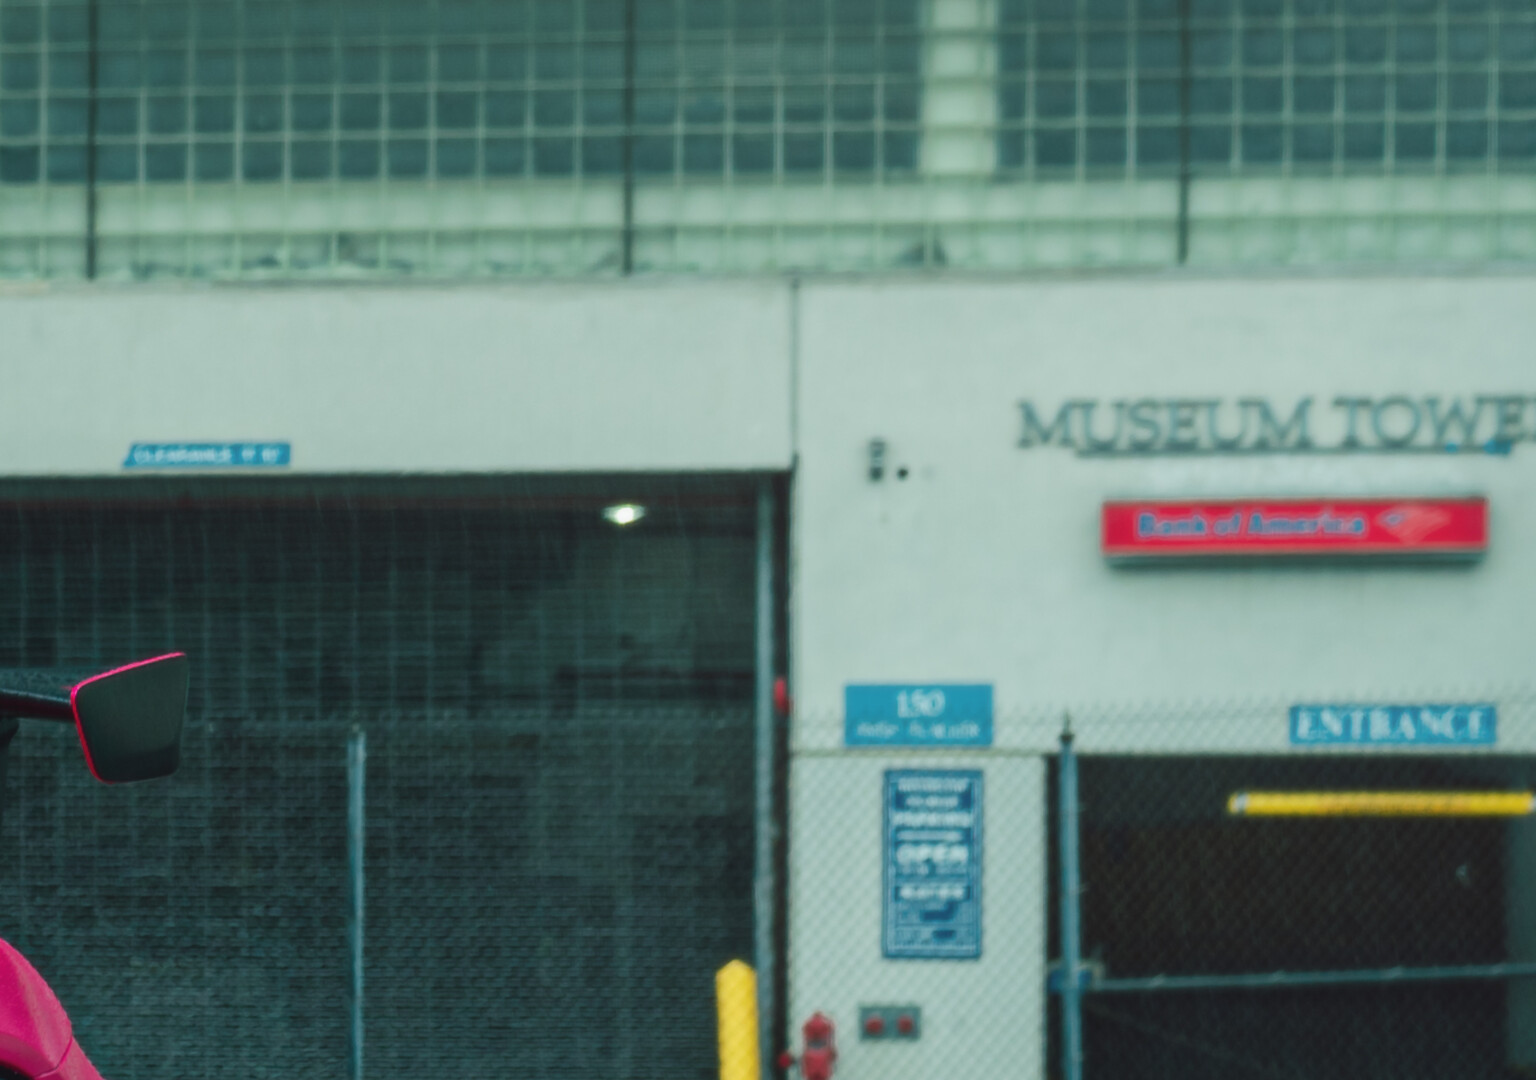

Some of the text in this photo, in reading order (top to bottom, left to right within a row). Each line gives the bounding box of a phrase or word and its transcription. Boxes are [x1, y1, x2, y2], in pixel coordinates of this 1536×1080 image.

[1016, 394, 1536, 450] MUSEUM TOWE
[1138, 510, 1365, 536] Bank of America
[897, 689, 946, 719] 150
[1297, 708, 1485, 740] ENTRANCE
